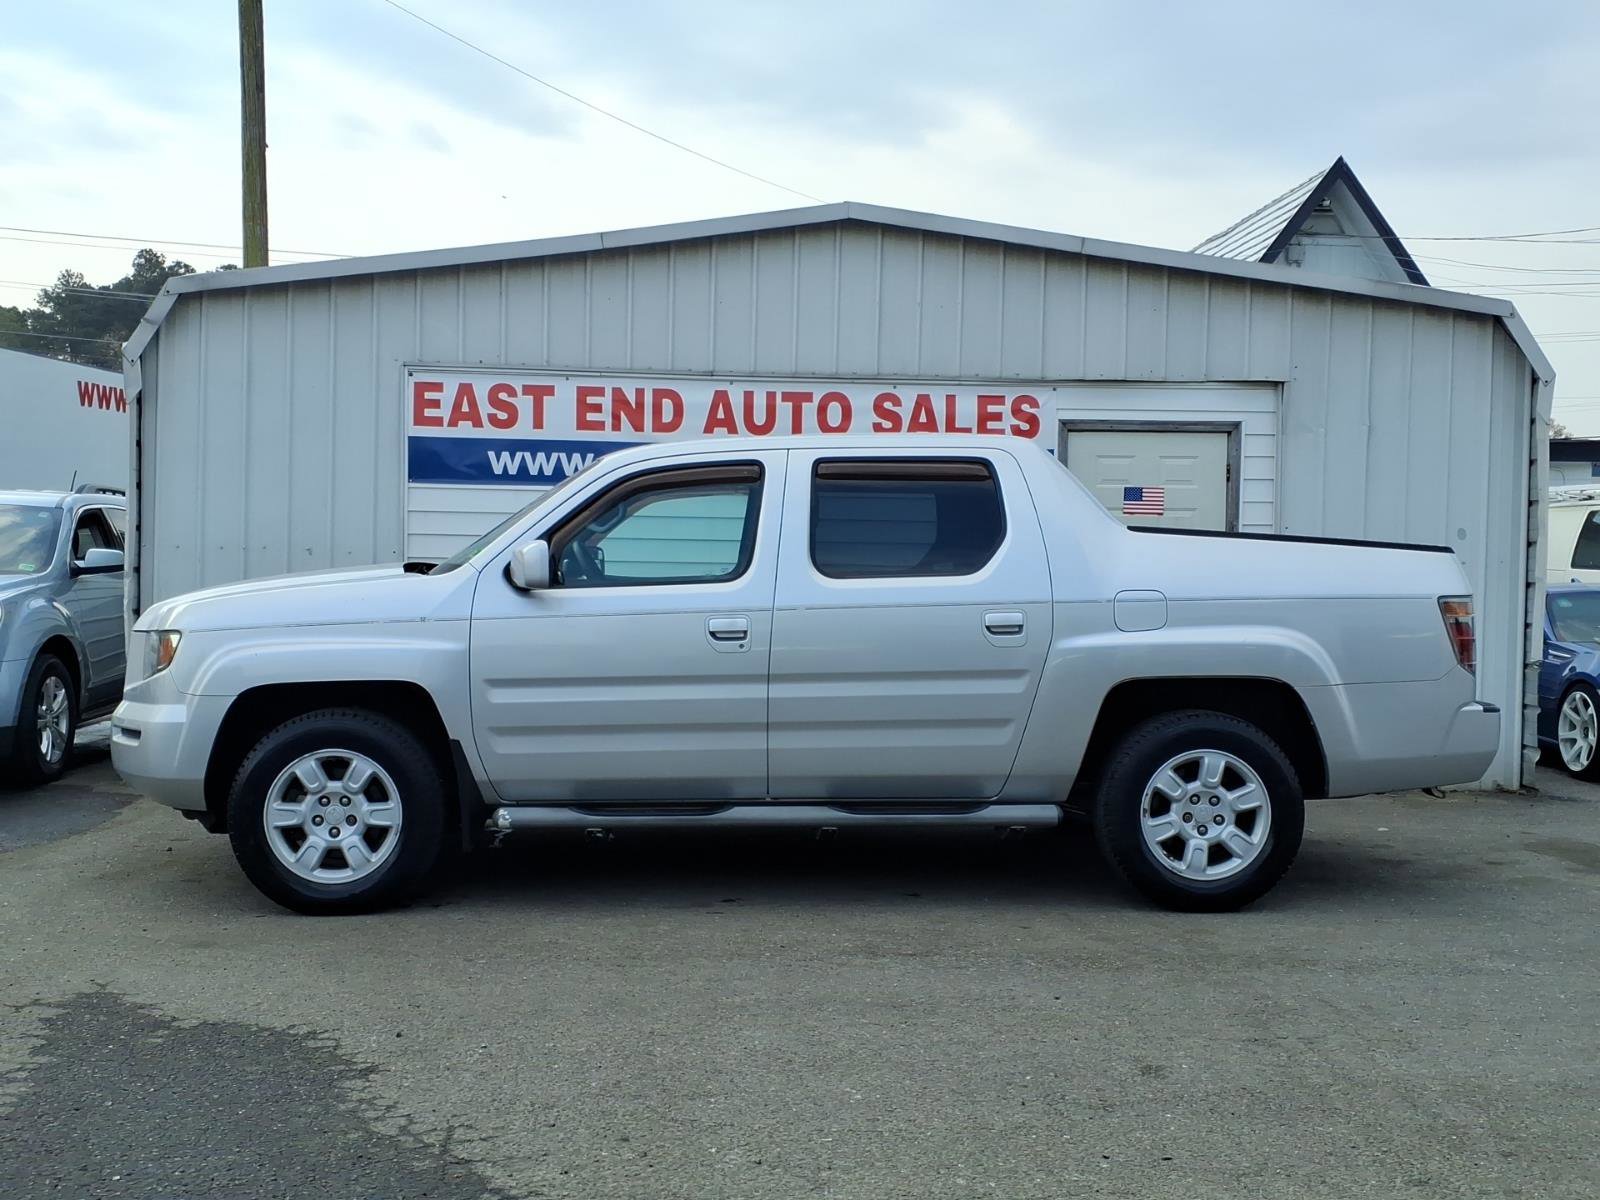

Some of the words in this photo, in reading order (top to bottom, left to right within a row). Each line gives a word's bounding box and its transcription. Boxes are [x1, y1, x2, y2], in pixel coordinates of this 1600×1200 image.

[412, 381, 555, 430] EAST
[575, 385, 685, 433] END
[702, 389, 853, 436] AUTO
[872, 392, 1041, 439] SALES
